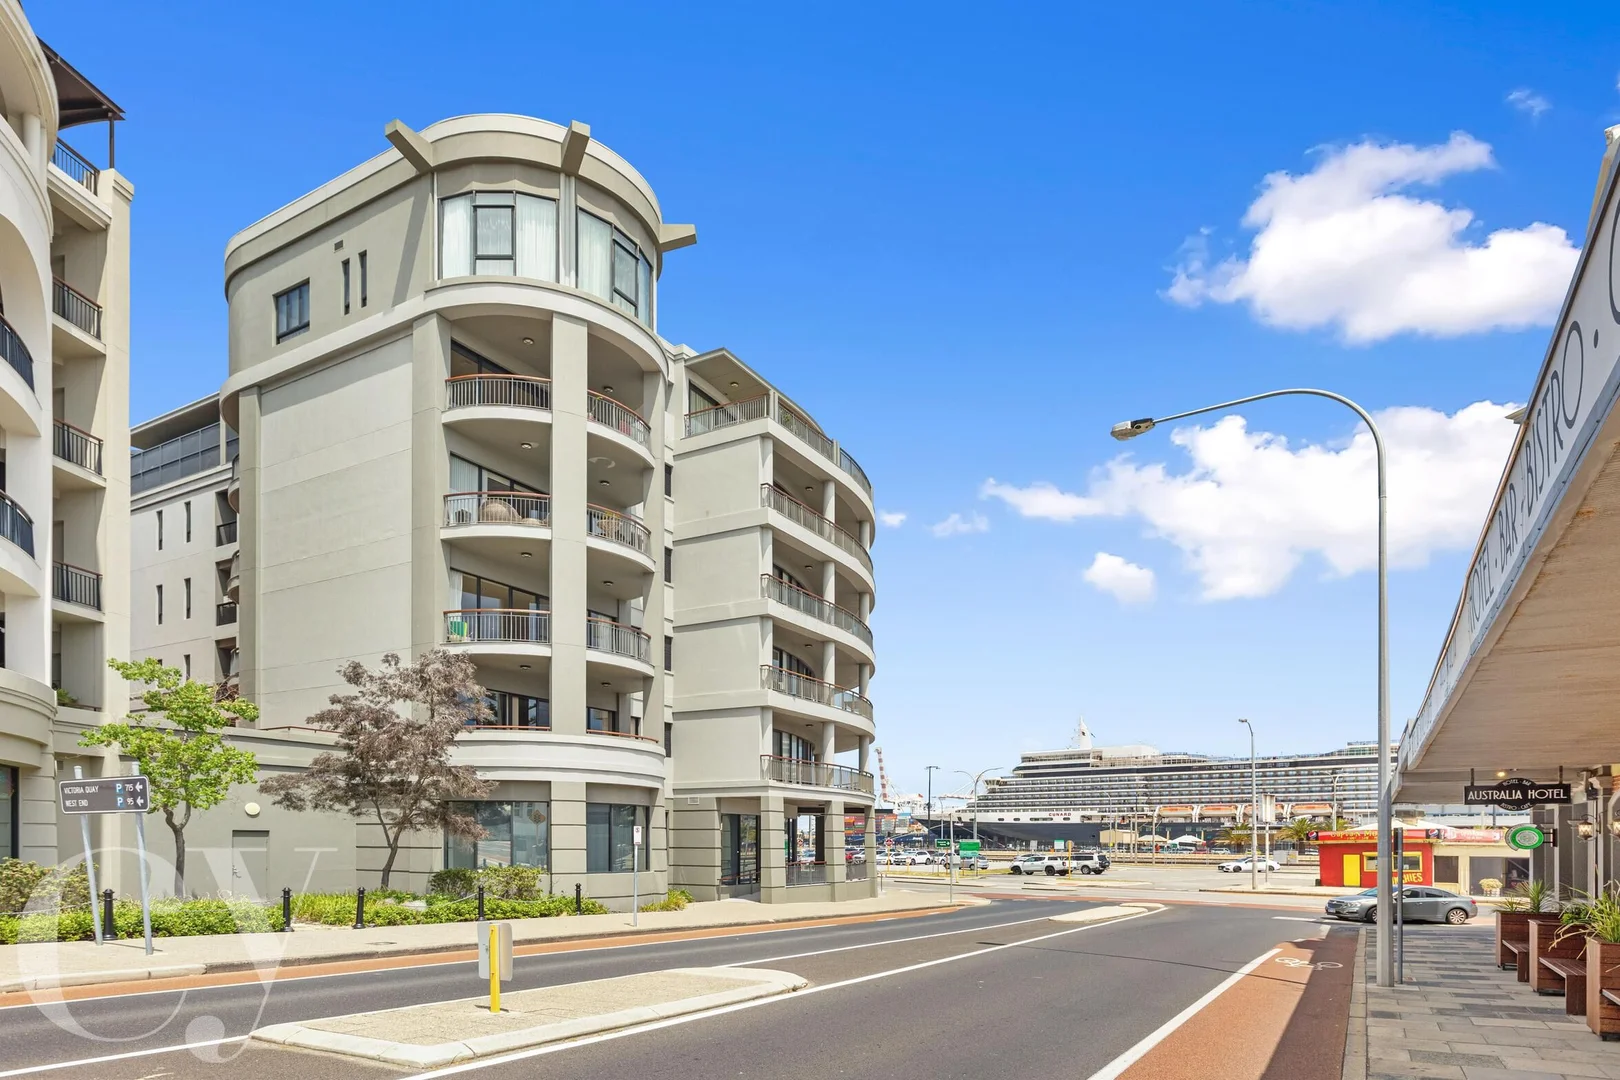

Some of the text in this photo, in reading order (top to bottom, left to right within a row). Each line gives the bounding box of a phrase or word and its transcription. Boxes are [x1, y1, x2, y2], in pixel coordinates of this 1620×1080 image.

[1498, 482, 1518, 574] BAR
[1524, 320, 1584, 518] BISTRO
[64, 786, 84, 795] VICTORIA
[85, 785, 99, 793] QUAY
[1467, 789, 1567, 801] AUSTRALIA HOTEL
[79, 799, 88, 807] END
